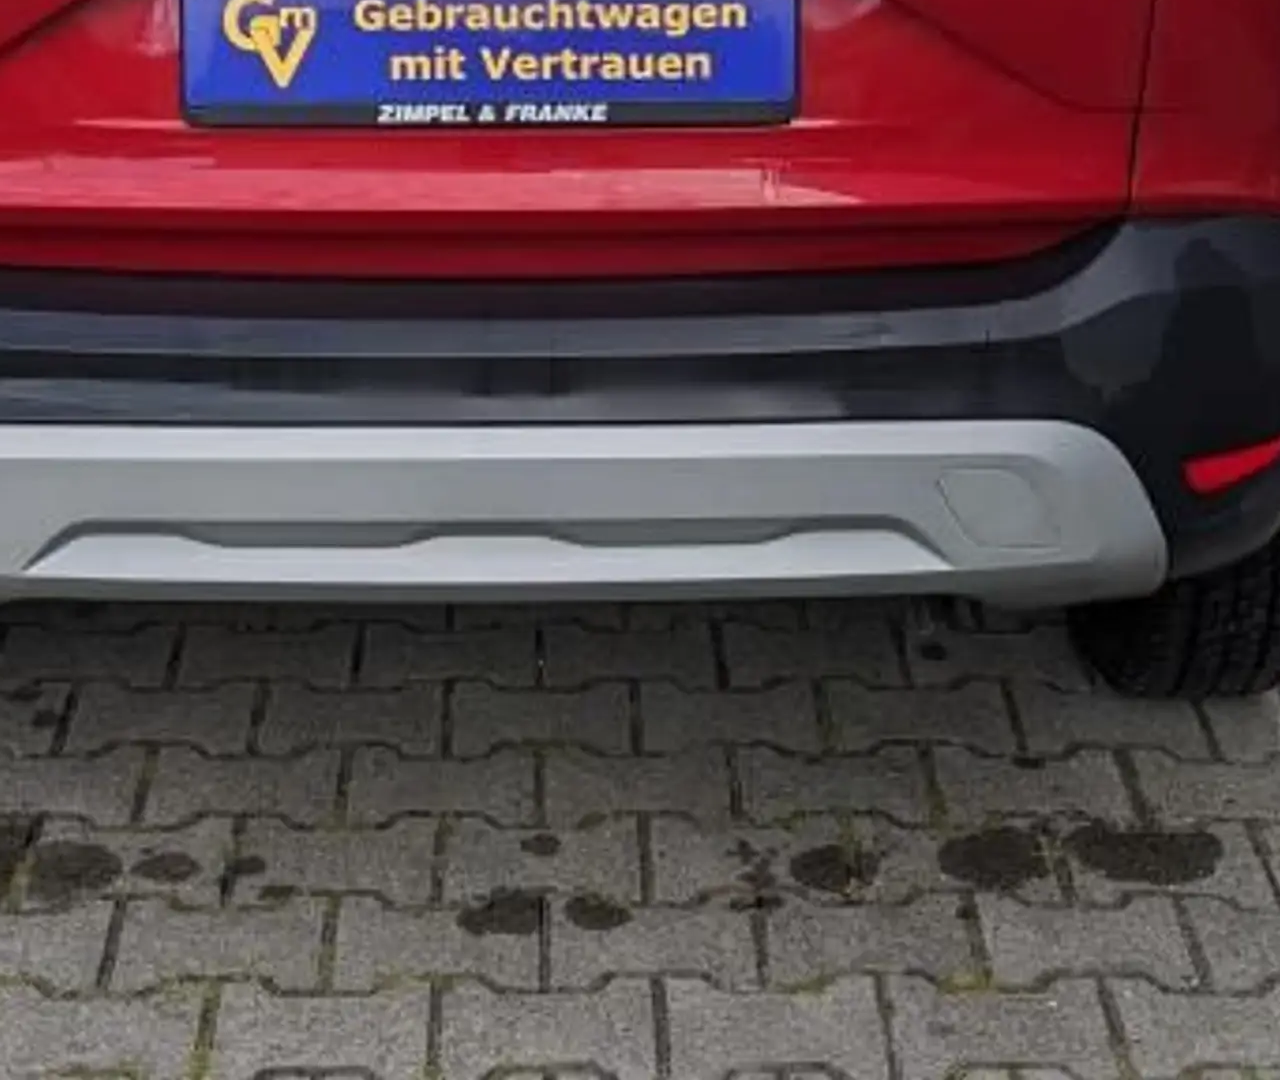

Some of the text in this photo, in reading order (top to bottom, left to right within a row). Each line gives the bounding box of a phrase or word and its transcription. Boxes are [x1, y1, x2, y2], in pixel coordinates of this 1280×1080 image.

[389, 45, 712, 83] mit Vertrauen
[377, 103, 608, 123] ZIMPEL & FRANKE
